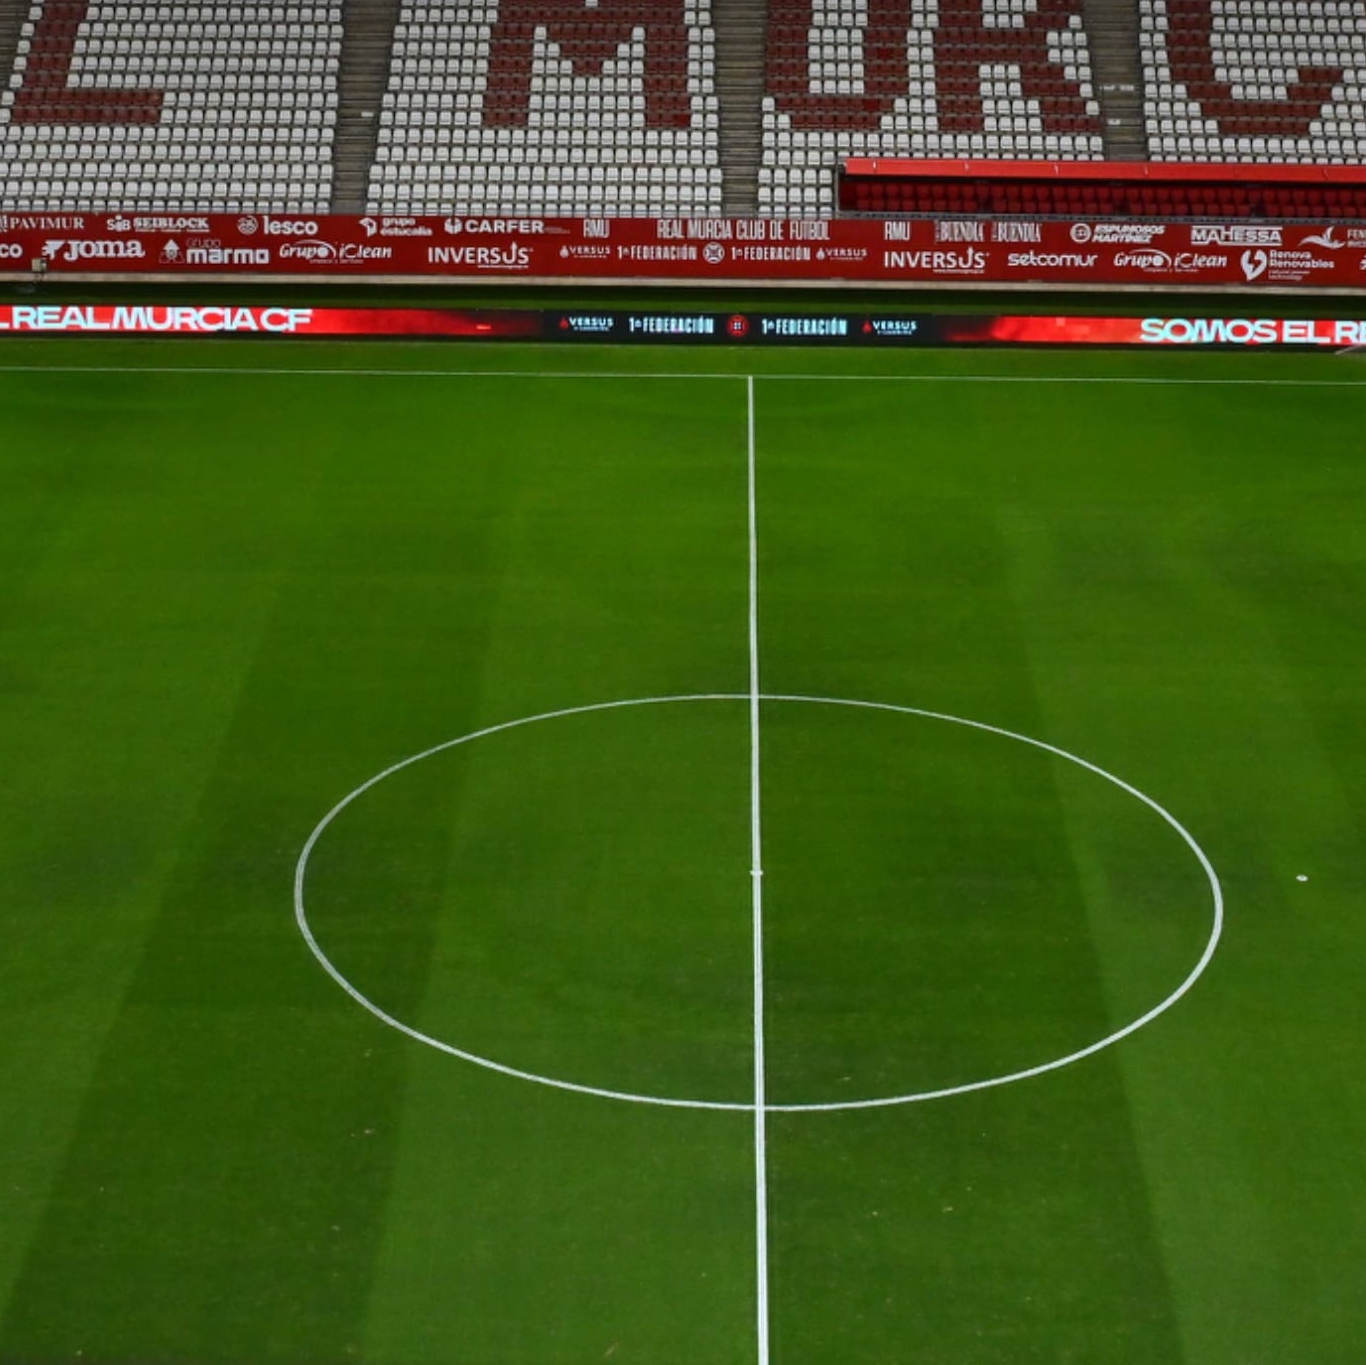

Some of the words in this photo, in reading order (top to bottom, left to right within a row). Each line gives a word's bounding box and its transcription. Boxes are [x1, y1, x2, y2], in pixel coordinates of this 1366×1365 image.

[10, 217, 85, 230] PAVIMUR
[264, 216, 318, 234] lesco
[465, 220, 544, 234] CARFER
[657, 219, 685, 239] REAL
[687, 219, 732, 240] MURCIA
[736, 220, 765, 240] CLUB
[770, 220, 784, 240] DE
[1191, 226, 1282, 245] MAHESSA
[186, 248, 270, 264] marmo
[428, 241, 529, 264] INVERSUS
[569, 246, 611, 255] VERSUS
[631, 244, 697, 260] FEDERACIÓN
[744, 245, 811, 261] FEDERACIÓN
[826, 248, 867, 257] VERSUS
[885, 247, 985, 268] INVERSUS
[1270, 251, 1311, 259] Renova
[1270, 259, 1334, 268] Renovables
[12, 306, 110, 330] REAL
[113, 306, 258, 331] MURCIA
[260, 308, 312, 332] CF
[569, 317, 613, 328] VERSUS
[643, 315, 714, 334] FEDERACIÓN
[776, 317, 847, 335] FEDERACIÓN
[872, 320, 917, 331] VERSUS
[1140, 318, 1277, 343] SOMOS
[1282, 320, 1330, 344] EL
